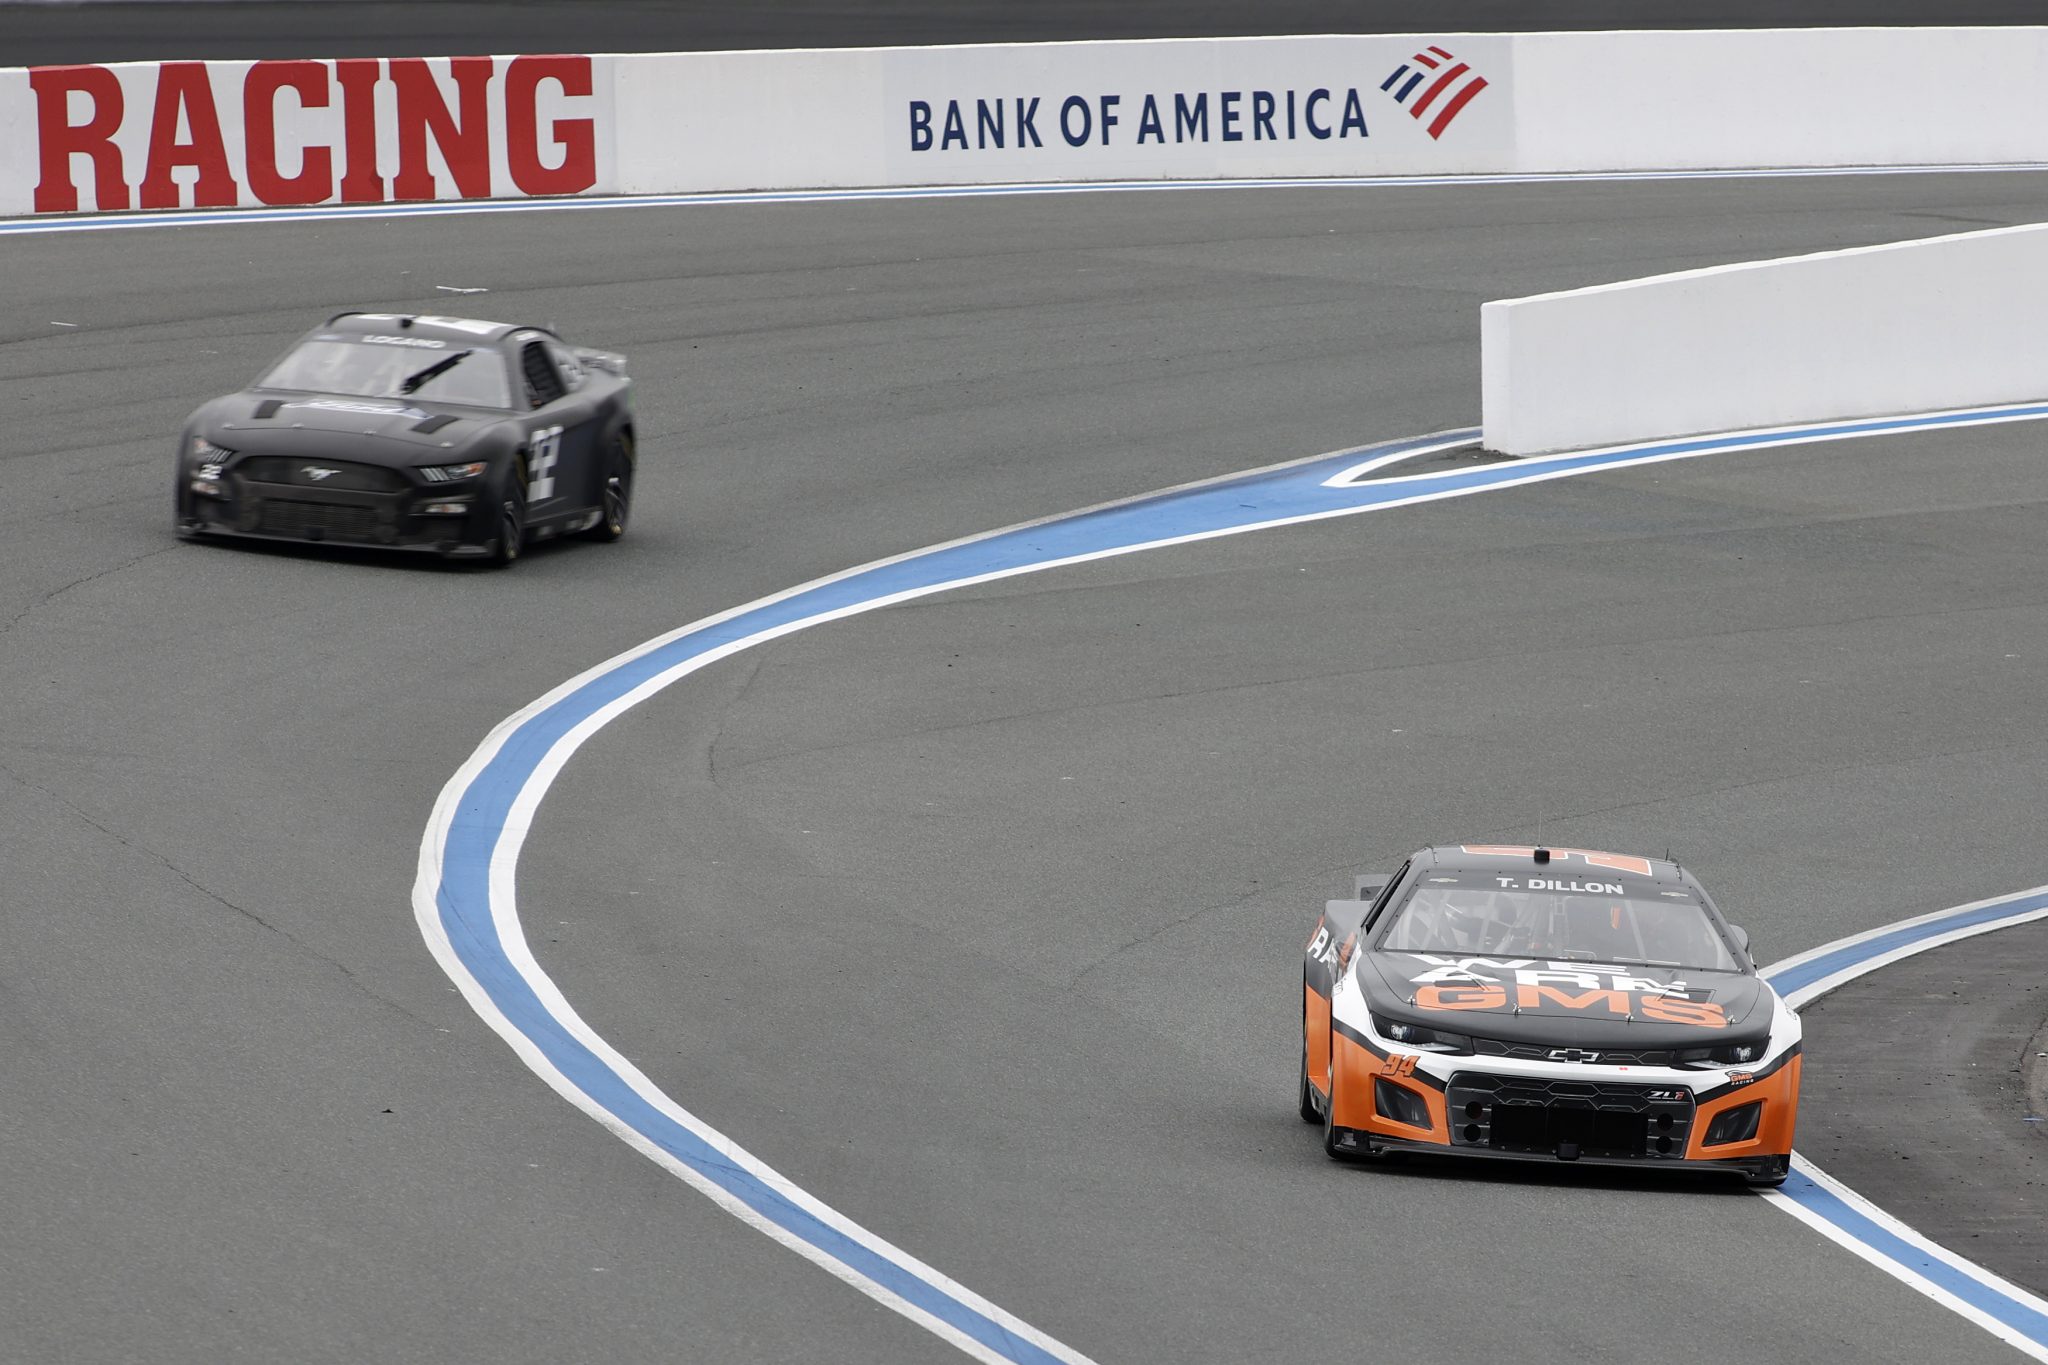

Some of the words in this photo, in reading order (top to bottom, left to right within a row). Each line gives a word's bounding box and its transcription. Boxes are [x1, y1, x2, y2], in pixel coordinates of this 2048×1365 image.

[29, 55, 594, 212] RACING
[910, 97, 1042, 151] BANK
[1060, 96, 1119, 147] OF
[1137, 88, 1368, 144] AMERICA
[1496, 877, 1519, 889] T.
[1527, 879, 1625, 895] DILLON
[1408, 952, 1631, 976] WE
[1416, 984, 1728, 1029] GMS
[1380, 1053, 1421, 1078] 94
